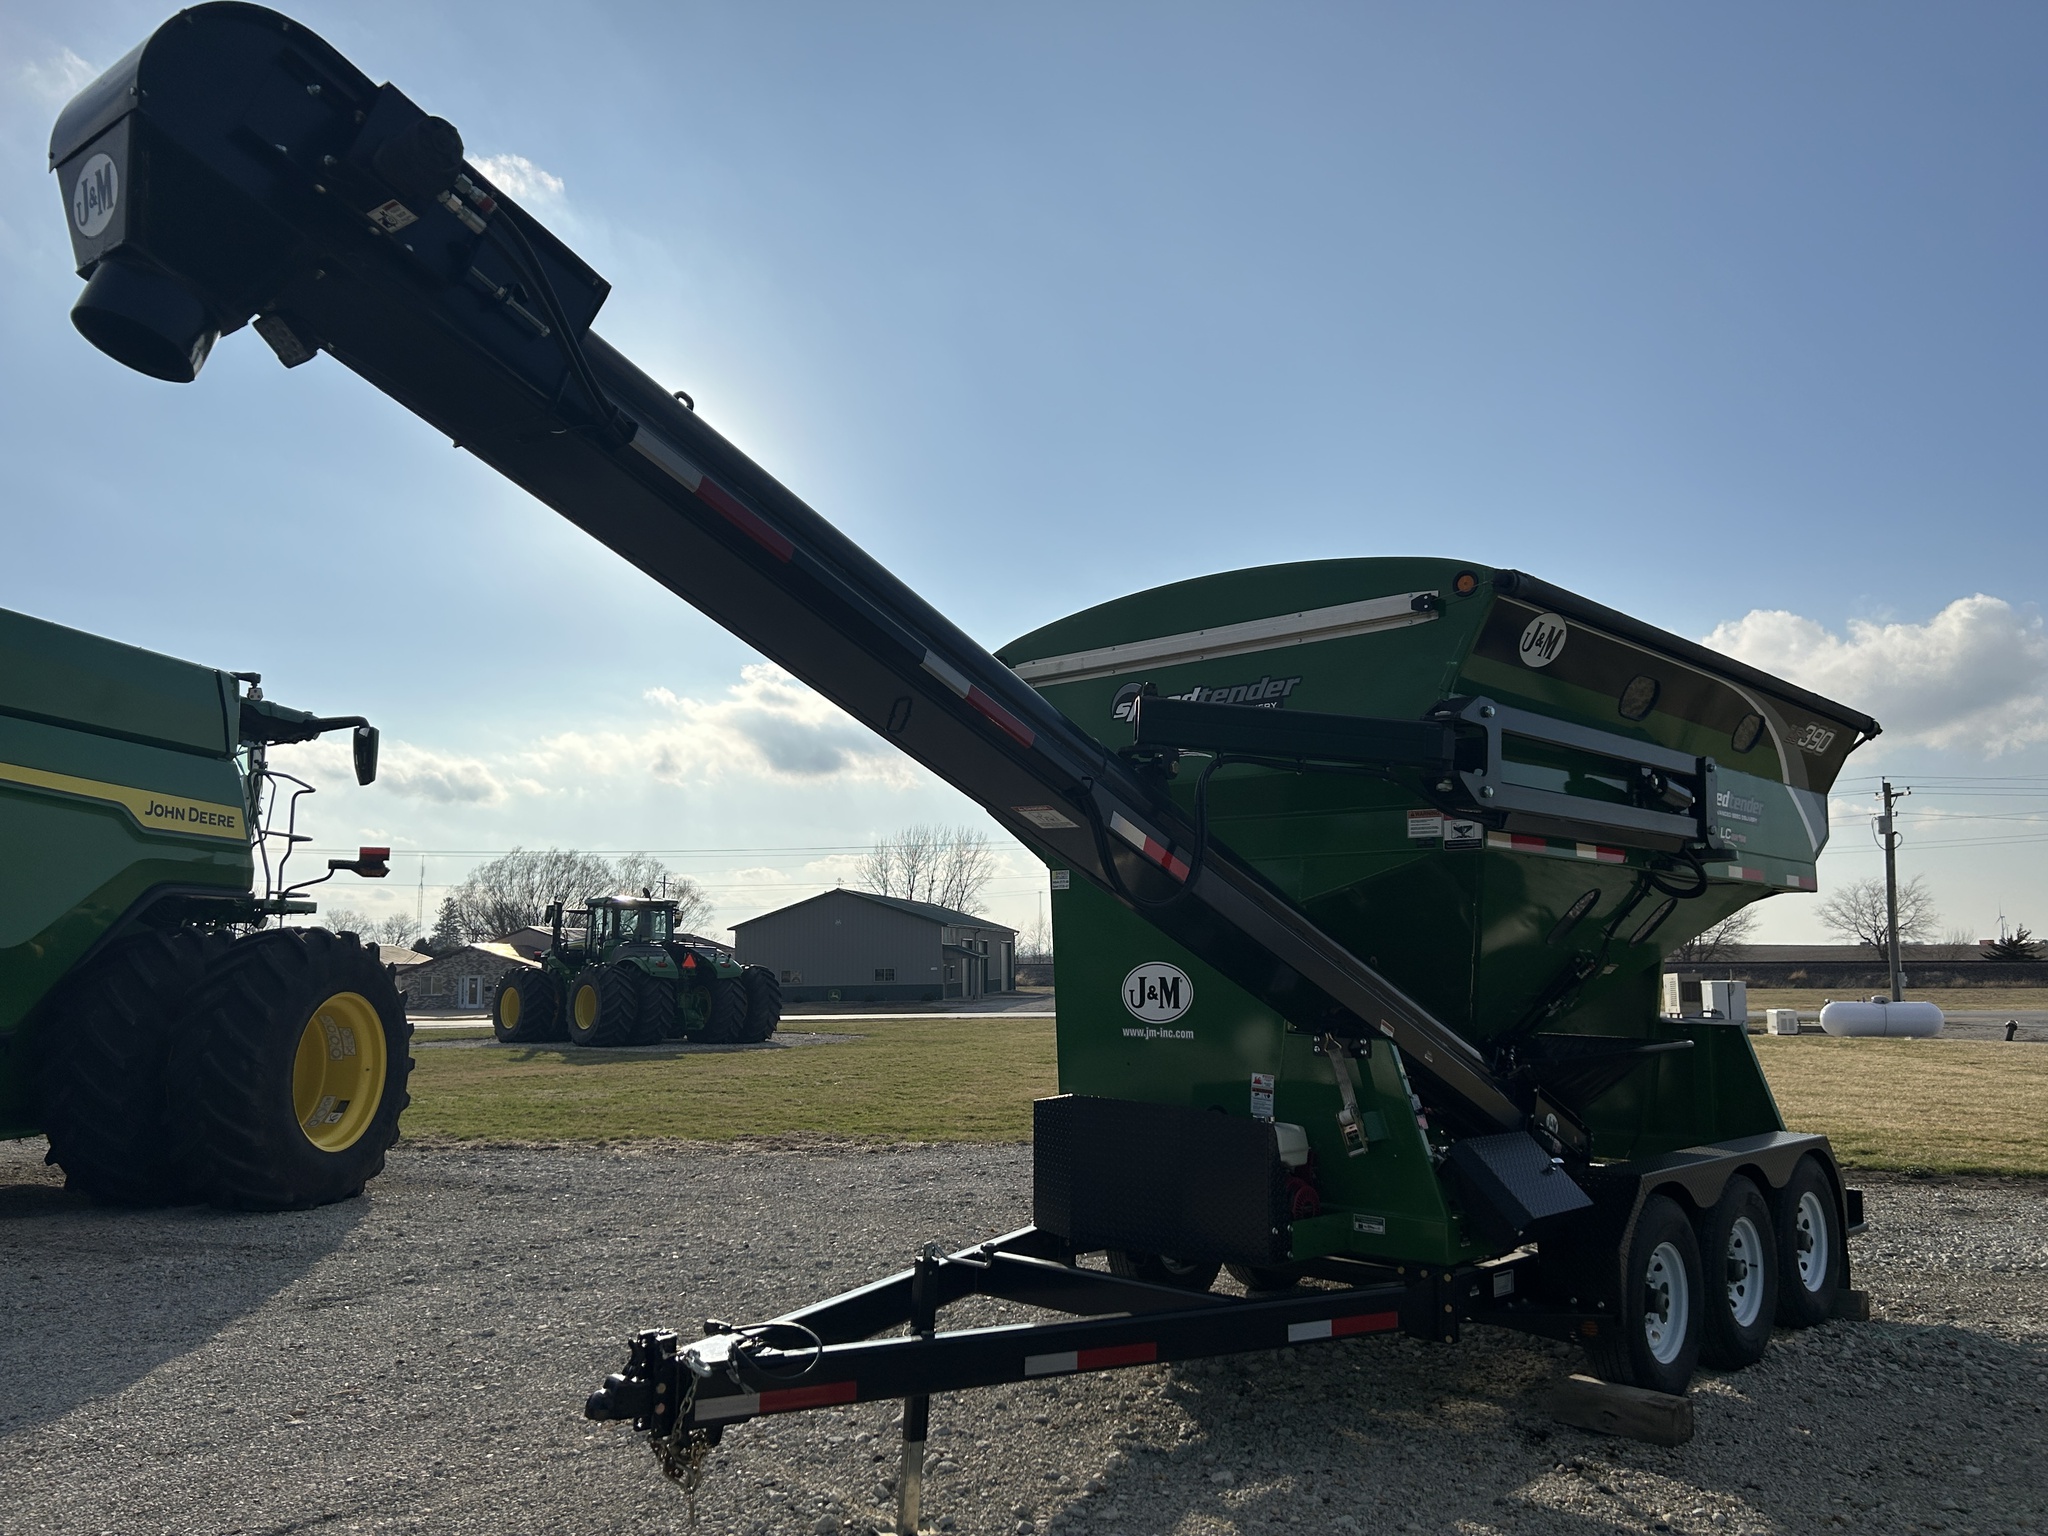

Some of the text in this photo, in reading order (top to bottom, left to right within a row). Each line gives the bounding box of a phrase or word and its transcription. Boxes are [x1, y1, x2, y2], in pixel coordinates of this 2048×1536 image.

[76, 161, 115, 227] J&M
[1522, 621, 1565, 660] J&M
[145, 800, 235, 828] JOHN DEERE
[1716, 790, 1764, 815] edtender
[1128, 976, 1182, 1010] J&M
[1122, 1027, 1194, 1040] www.jm-inc.com
